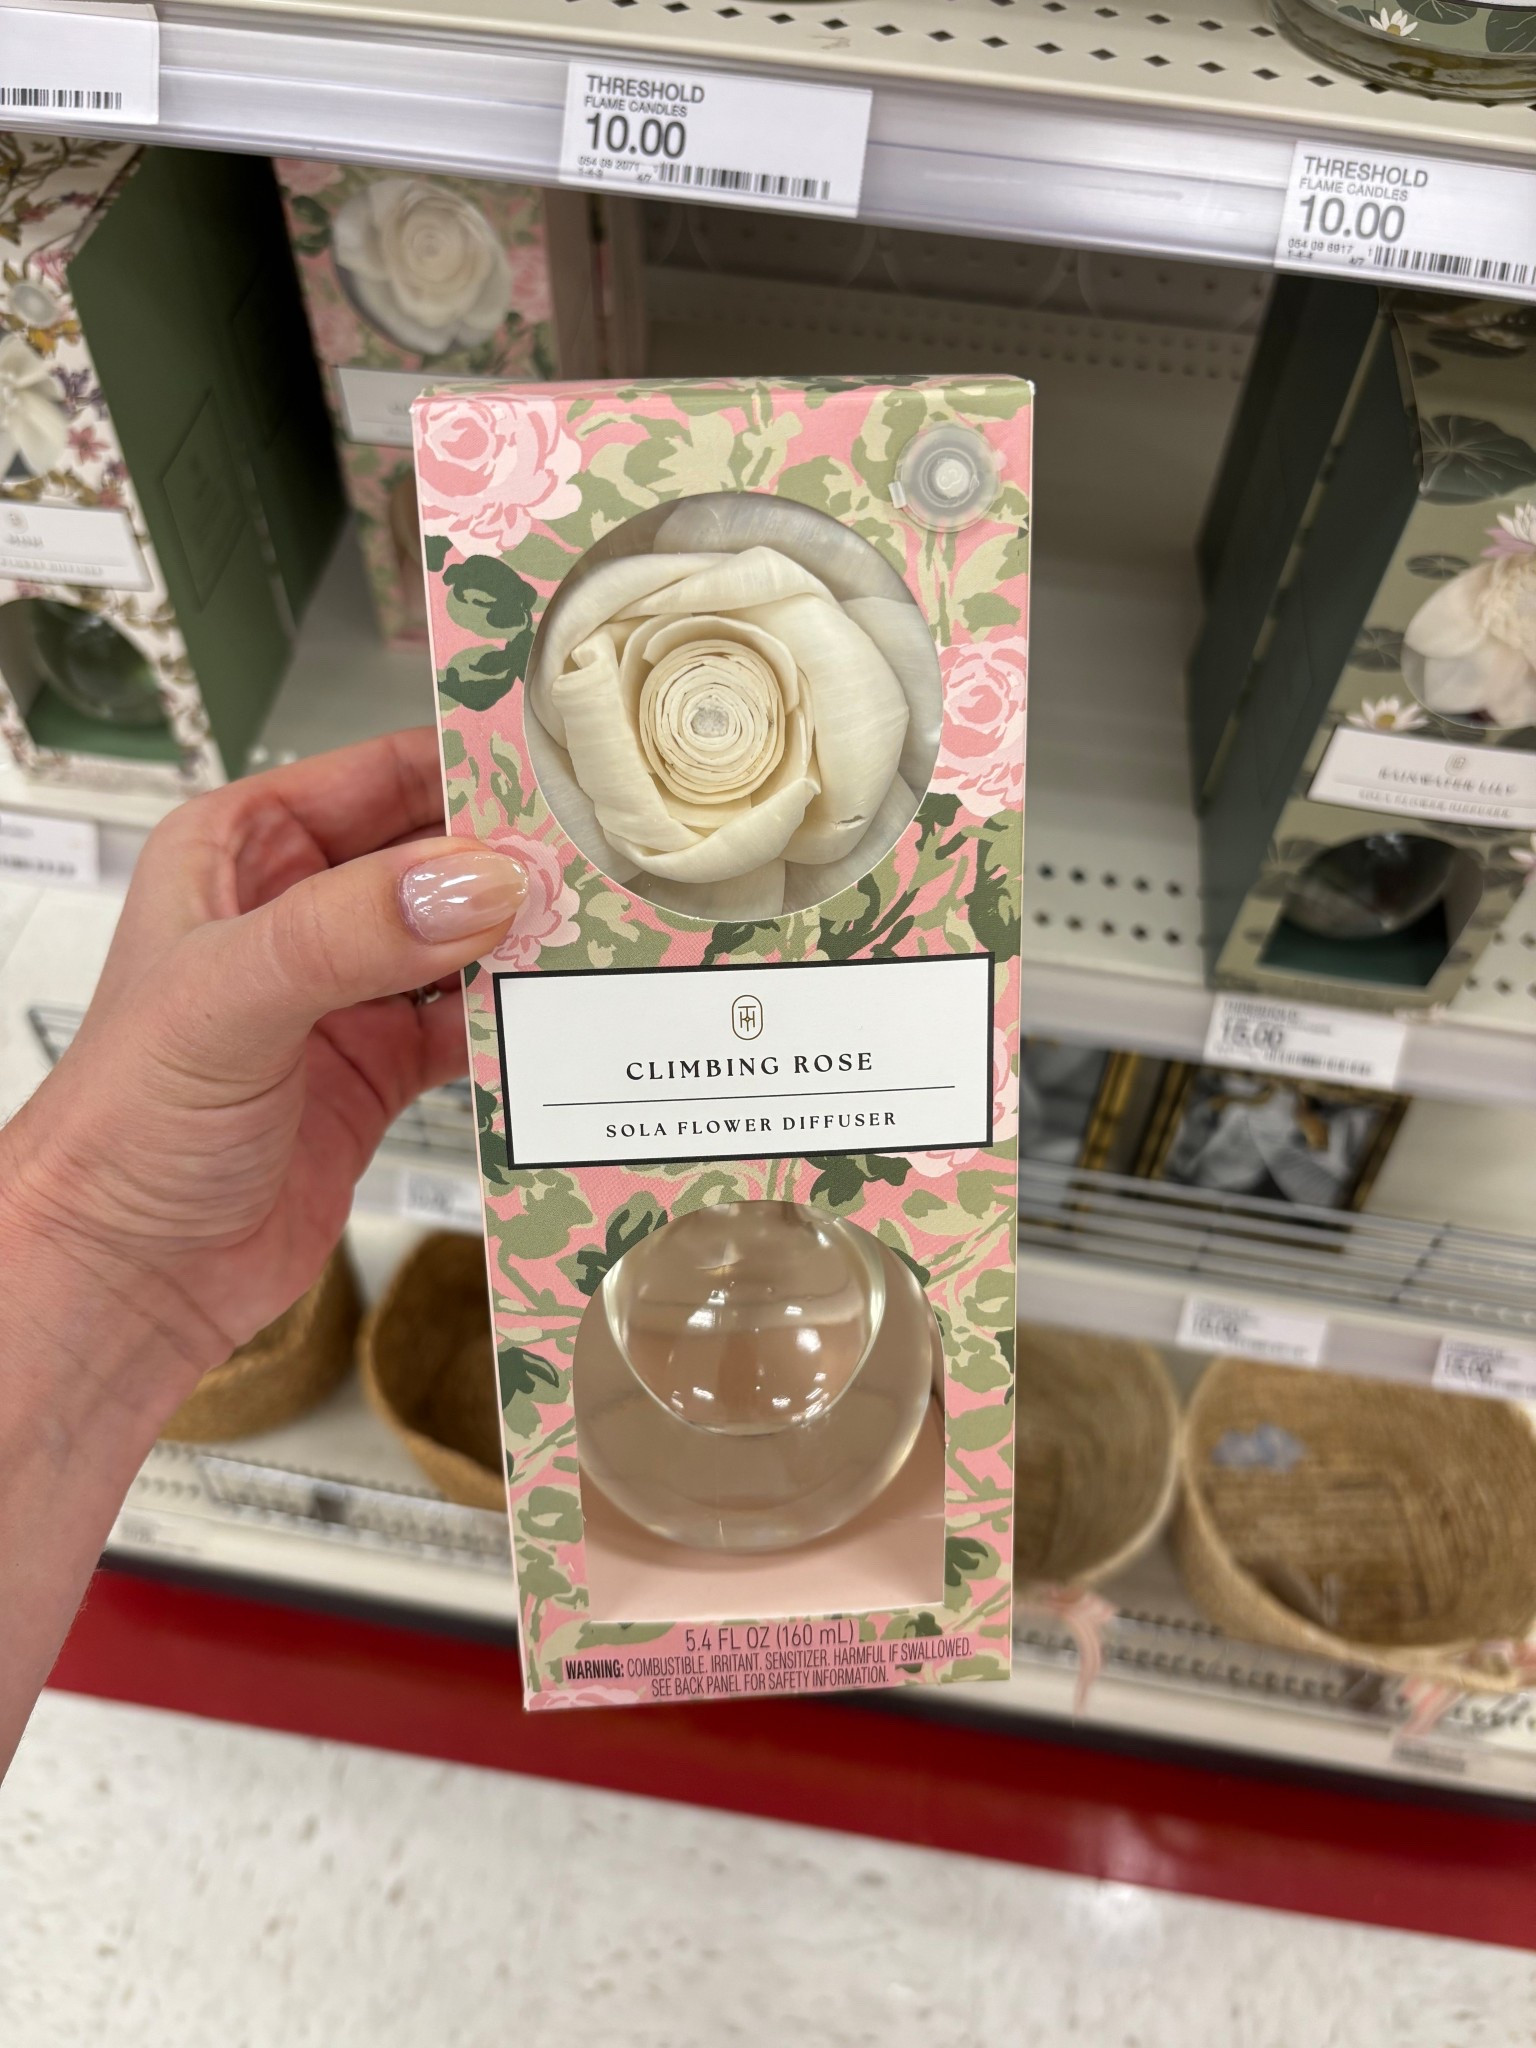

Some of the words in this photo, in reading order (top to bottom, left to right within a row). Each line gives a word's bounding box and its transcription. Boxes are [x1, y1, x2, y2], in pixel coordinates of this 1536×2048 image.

[586, 74, 705, 104] THRESHOLD
[584, 95, 626, 112] FLAME
[629, 100, 688, 118] CANDLES
[586, 112, 687, 160] 10.00
[1304, 155, 1429, 188] THRESHOLD
[1299, 178, 1344, 193] FLAME
[1347, 183, 1409, 202] CANDLES
[1300, 194, 1406, 244] 10.00
[626, 1056, 779, 1081] CLIMBING
[794, 1052, 873, 1074] ROSE
[606, 1122, 667, 1138] SOLA
[677, 1118, 772, 1135] FLOWER
[783, 1112, 896, 1131] DIFFUSER
[685, 1628, 712, 1652] 5.4
[718, 1627, 741, 1650] FL
[746, 1626, 771, 1649] OZ
[776, 1623, 813, 1649] (160
[819, 1619, 854, 1645] mL)
[565, 1659, 625, 1680] WARNING:
[627, 1655, 708, 1677] COMBUSTIBLE.
[711, 1652, 762, 1673] IRRITANT.
[765, 1648, 830, 1670] SENSITIZER.
[833, 1645, 886, 1665] HARMFUL
[889, 1643, 898, 1662] IF
[901, 1637, 972, 1661] SWALLOWED.
[652, 1678, 672, 1697] SEE
[675, 1676, 704, 1695] BACK
[707, 1674, 741, 1693] PANEL
[744, 1673, 766, 1691] FOR
[768, 1669, 810, 1690] SAFETY
[812, 1665, 889, 1687] INFORMATION.
